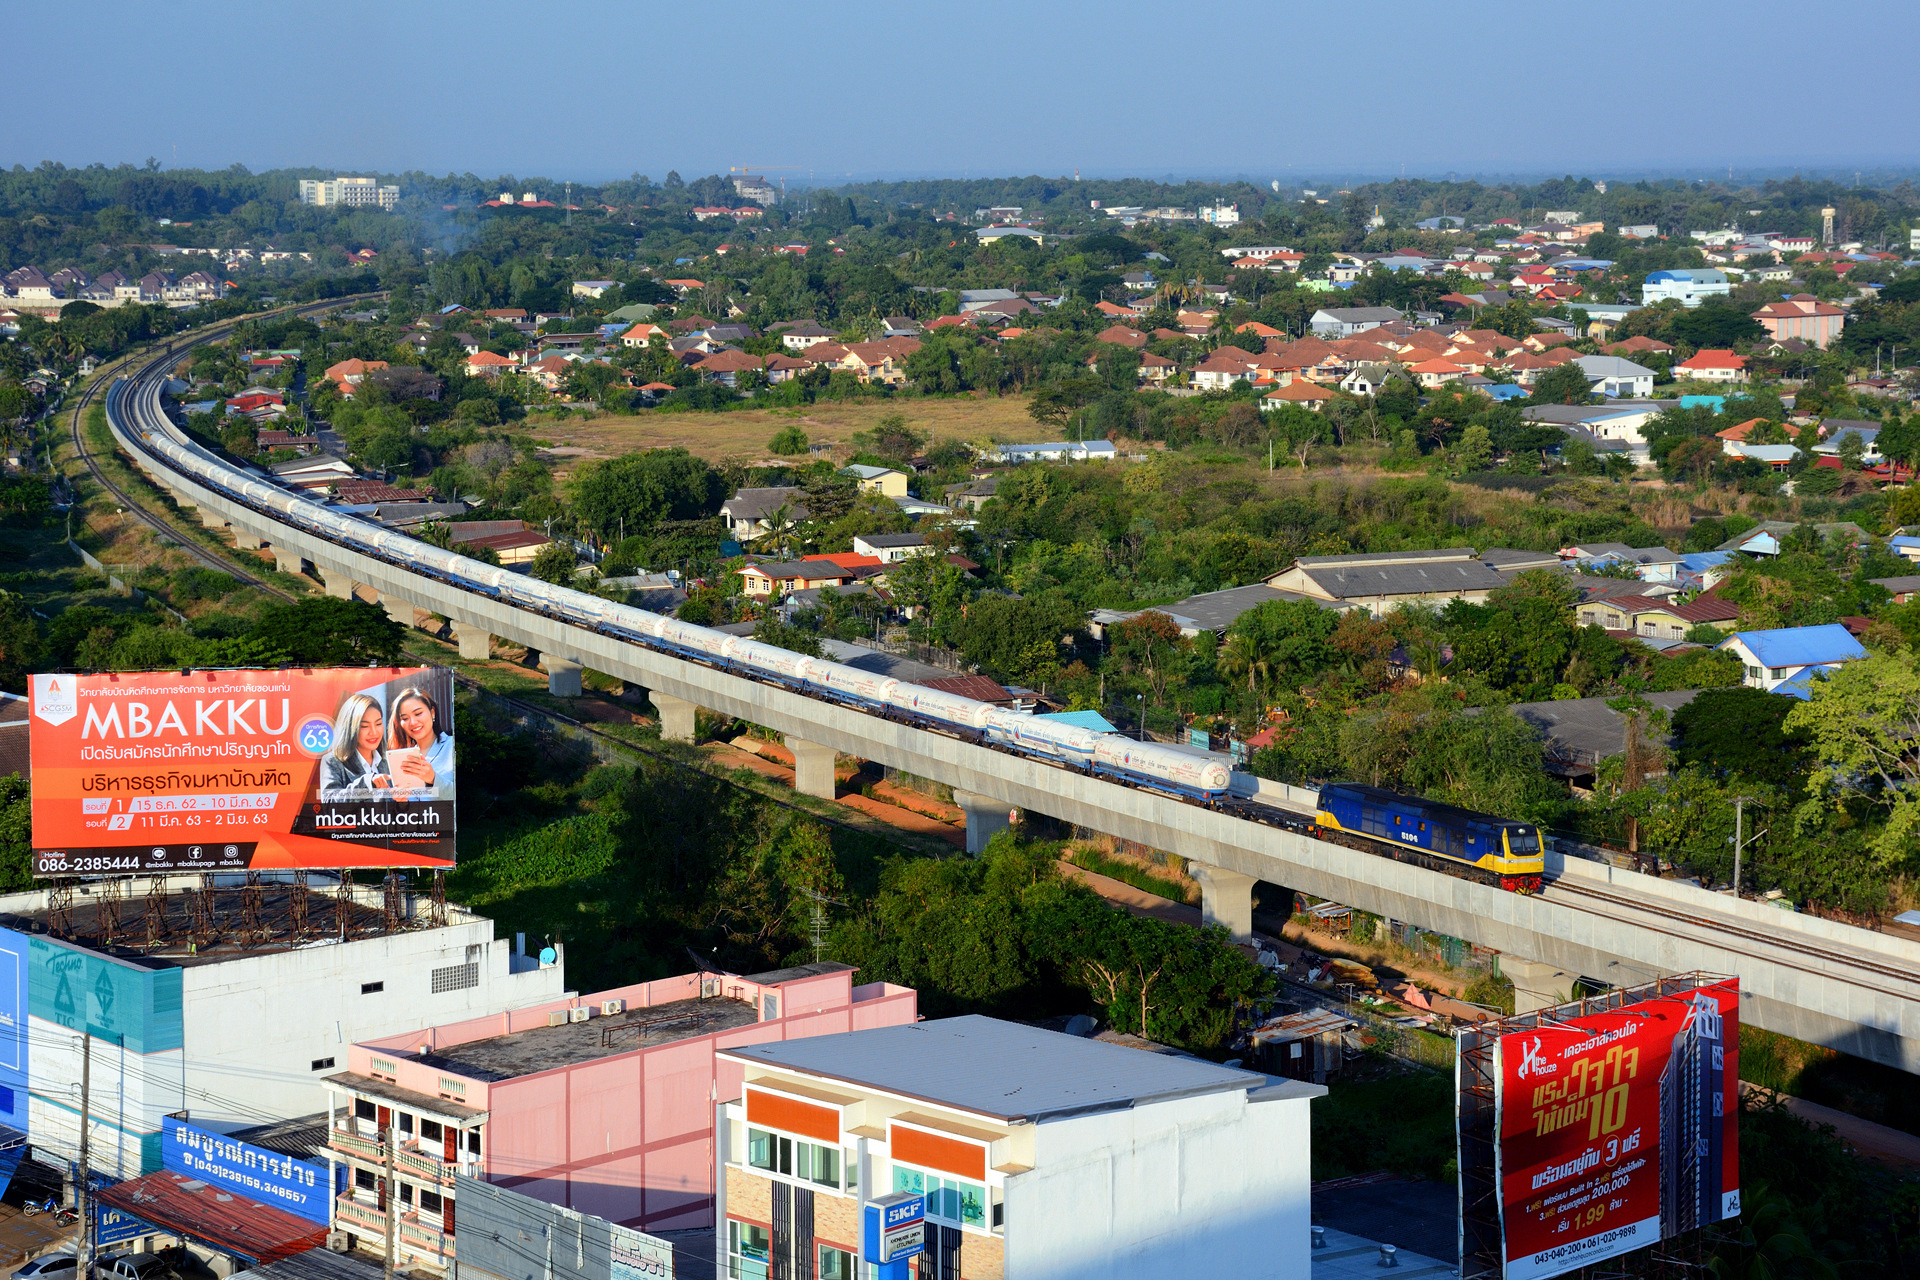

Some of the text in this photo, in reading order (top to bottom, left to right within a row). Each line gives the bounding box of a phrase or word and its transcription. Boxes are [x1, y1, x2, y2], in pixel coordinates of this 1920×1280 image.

[80, 682, 290, 697] วิทยาลัยบัณฑิตศึกษาการจัดการ มหาวิทยาลัยขอนแก่น
[81, 698, 290, 740] MBA KKU
[303, 729, 330, 748] 63
[81, 740, 291, 760] เปิดรับสมัครนักศึกษาปริญญาโท
[82, 768, 291, 794] บริหารธุรกิจมหาบัณฑิต
[85, 801, 107, 811] รอบที่
[116, 799, 123, 812] 1
[137, 800, 152, 811] 15
[155, 799, 178, 811] ธ.ค.
[181, 798, 197, 809] 62
[211, 798, 225, 808] 10
[229, 796, 252, 808] มี.ค.
[255, 796, 271, 807] 63
[85, 818, 108, 828] รอบที่
[116, 816, 126, 829] 2
[141, 816, 154, 828] 11
[159, 815, 182, 827] มี.ค.
[186, 815, 201, 826] 63
[215, 814, 223, 825] 2
[253, 813, 268, 824] 63
[315, 806, 440, 827] mba.kku.ac.th
[39, 857, 140, 872] 086-2385444
[177, 860, 215, 868] mbakkupage
[219, 858, 244, 866] mba.kku
[55, 1012, 75, 1029] TIC
[1535, 1056, 1547, 1066] the
[1535, 1063, 1558, 1076] houze
[176, 1126, 315, 1187] สมบูรณ์การช่าง
[1531, 1127, 1641, 1190] พร้อมอยู่กับ 3 ฟรี
[1569, 1184, 1585, 1197] Built
[889, 1203, 921, 1223] SKF
[1574, 1203, 1606, 1231] 1.99
[1587, 1224, 1637, 1249] 061-020-9898
